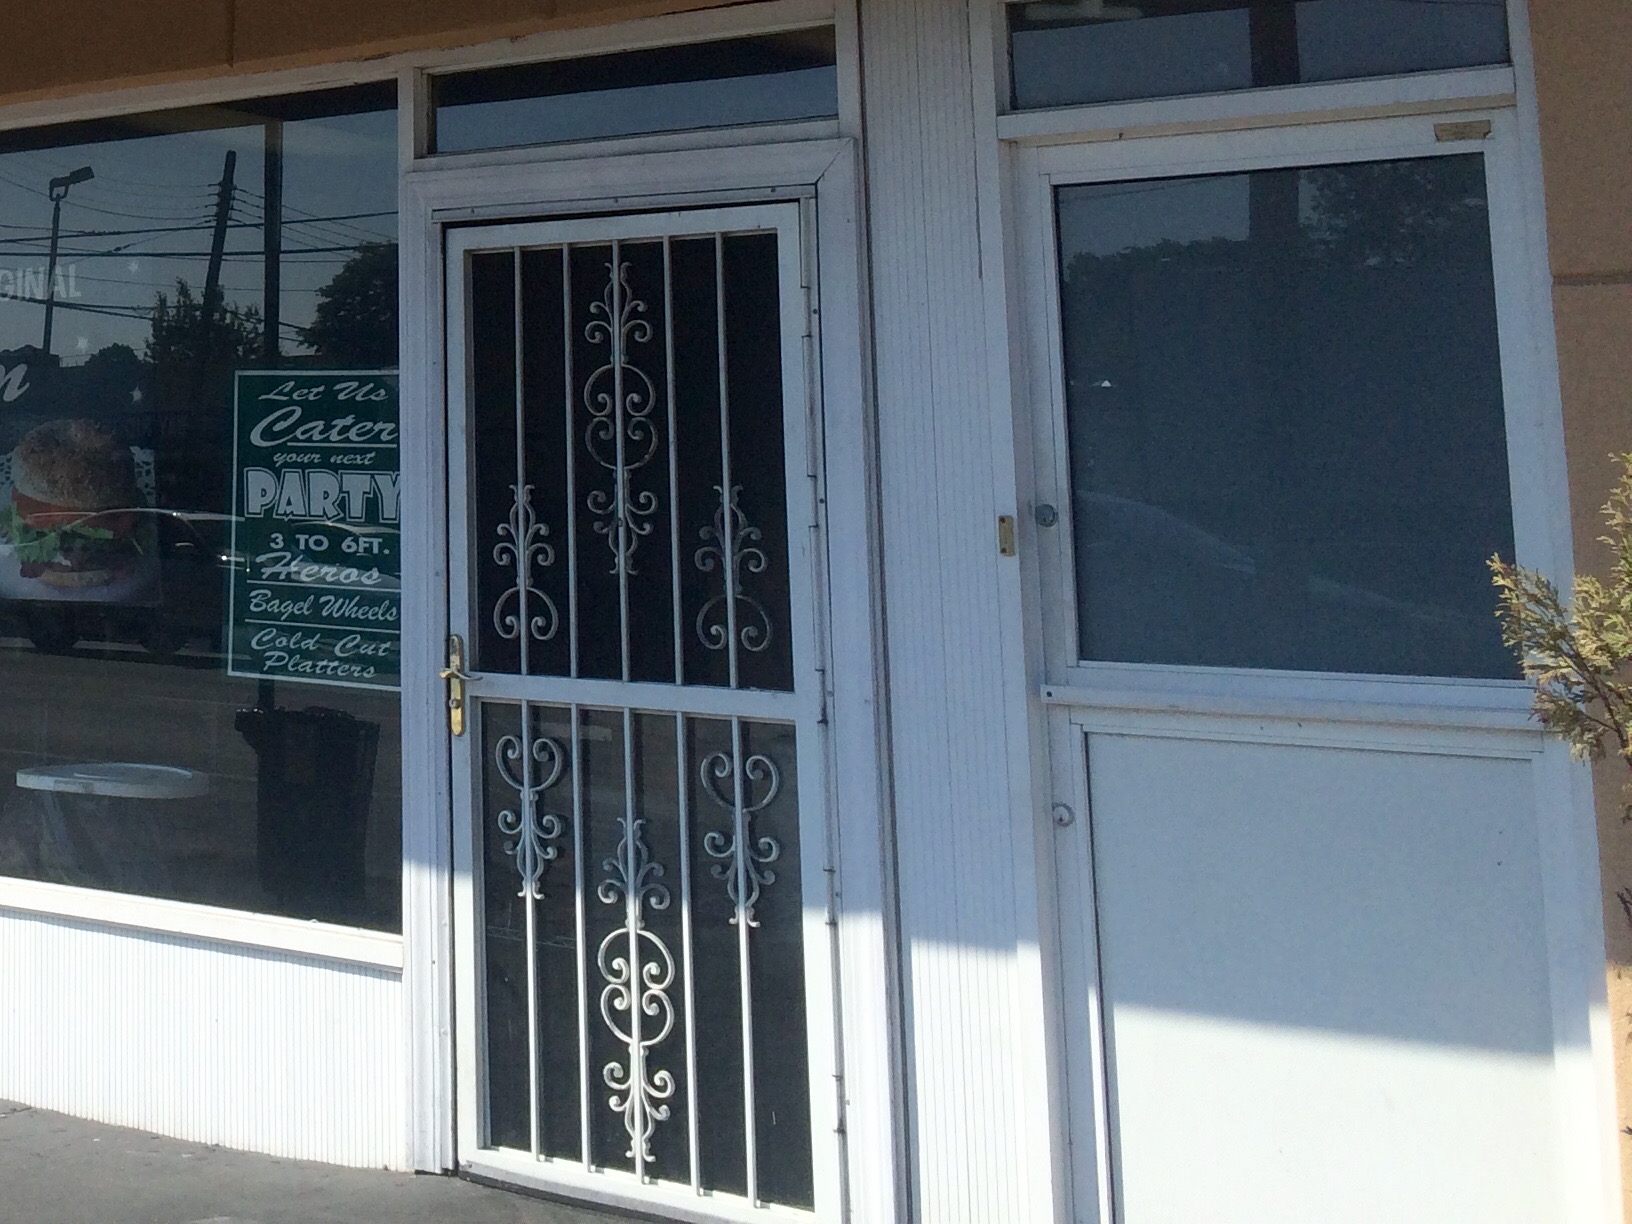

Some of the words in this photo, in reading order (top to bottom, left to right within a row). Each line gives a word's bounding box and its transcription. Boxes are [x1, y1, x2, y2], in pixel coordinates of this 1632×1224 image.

[258, 380, 325, 402] Let
[333, 381, 388, 402] Us
[250, 405, 399, 447] Cater
[273, 452, 321, 467] your
[330, 451, 376, 466] next
[243, 467, 401, 524] PARTY
[269, 533, 284, 550] 3
[295, 534, 329, 552] TO
[255, 551, 383, 586] Heros
[249, 589, 313, 624] Bagel
[319, 595, 398, 622] Wheels
[250, 627, 321, 652] Cold
[334, 633, 391, 658] Cut
[263, 651, 378, 678] Platters
